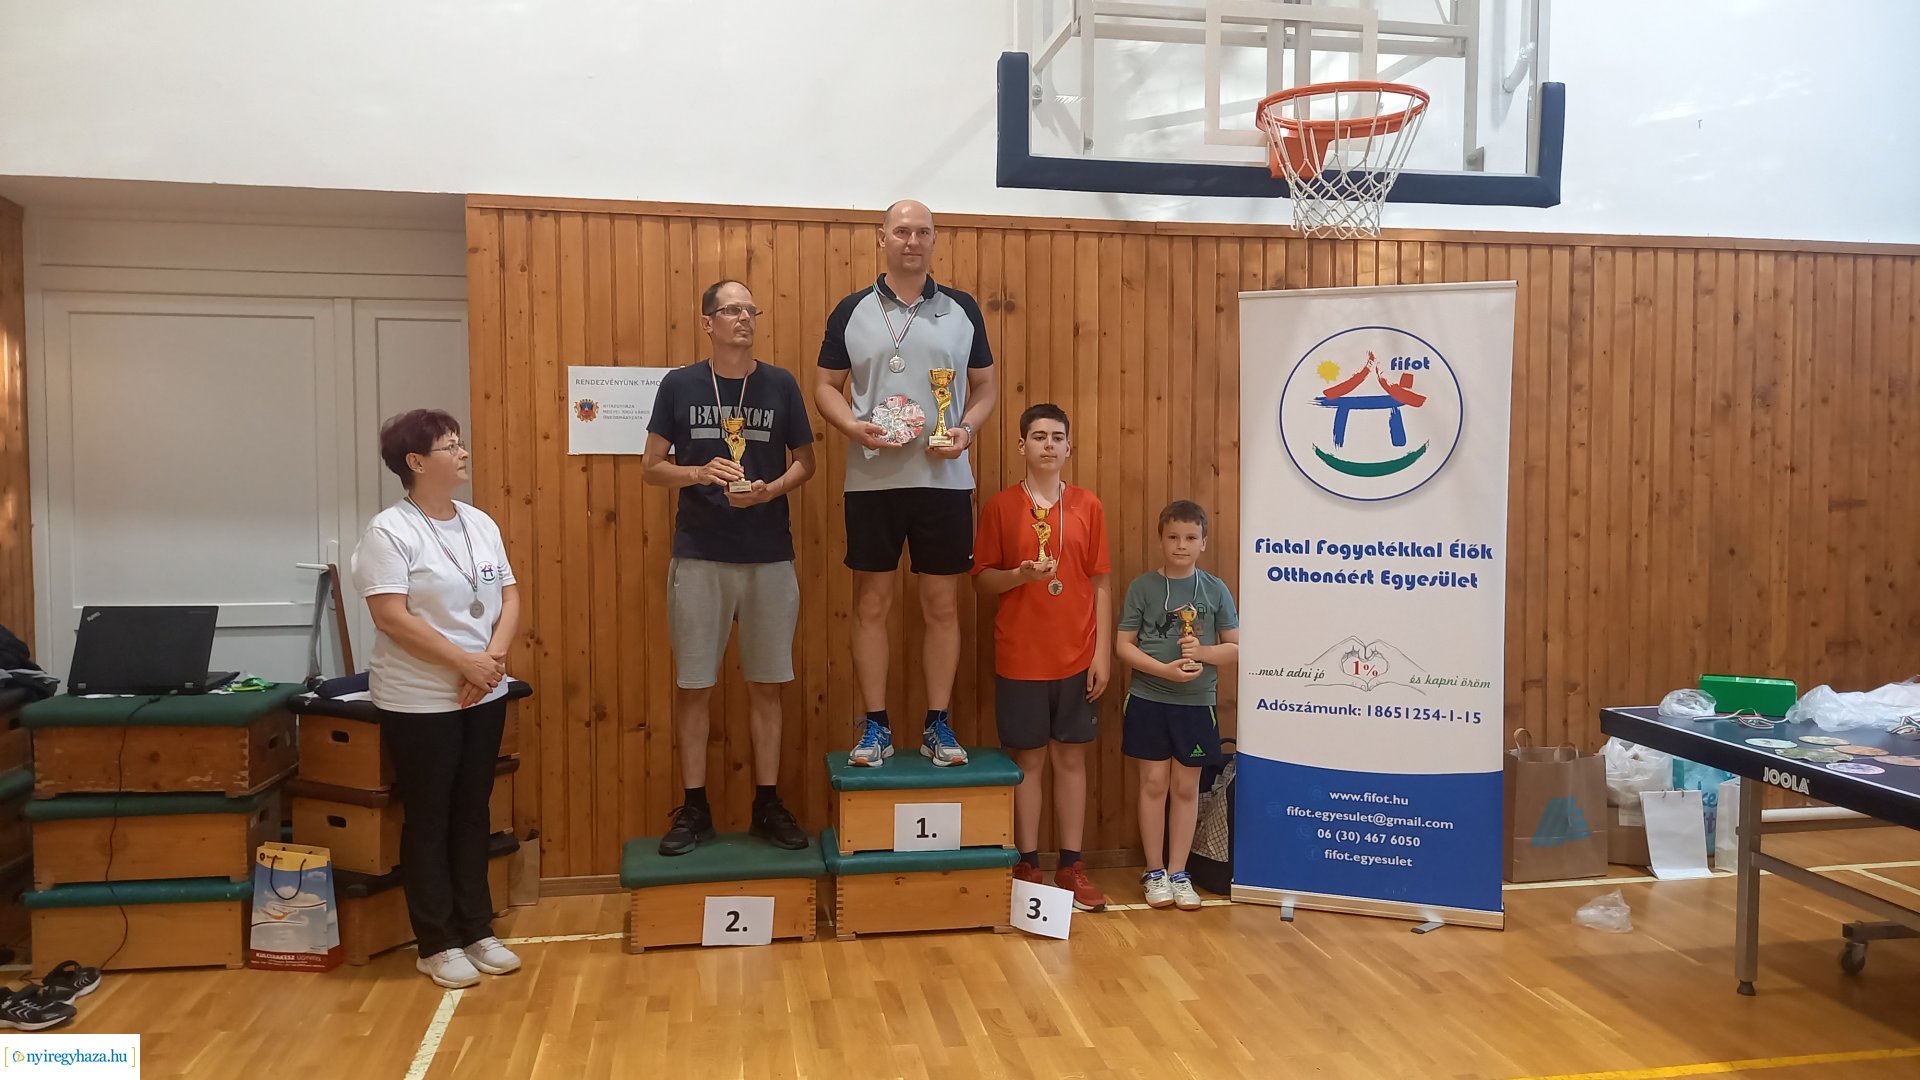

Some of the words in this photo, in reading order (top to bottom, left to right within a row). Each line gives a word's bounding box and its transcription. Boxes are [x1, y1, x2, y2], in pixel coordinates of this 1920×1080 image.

[1390, 356, 1431, 371] fifot
[575, 377, 639, 386] RENDEZVÉNYÜNK
[1255, 538, 1310, 554] Fiatal
[1316, 540, 1442, 560] Fogyatékkal
[1449, 539, 1493, 560] Élők
[1267, 566, 1374, 585] Otthonáért
[1380, 570, 1478, 590] Egyesület
[1286, 667, 1313, 679] adni
[1313, 669, 1325, 681] jó
[1352, 660, 1379, 677] 1%
[1409, 673, 1422, 684] és
[1424, 675, 1458, 688] kapni
[1462, 677, 1491, 689] öröm
[1256, 698, 1362, 716] Adószámunk:
[1367, 704, 1482, 724] 18651254-1-15
[1762, 766, 1809, 795] JOOLA
[1329, 791, 1409, 806] www.fifot.hu
[915, 817, 938, 839] 1.
[1286, 806, 1454, 830] fifot.egyesulet@gmail.com
[1317, 828, 1332, 840] 06
[1335, 830, 1361, 844] (30)
[1364, 832, 1387, 844] 467
[1390, 835, 1421, 847] 6050
[1324, 849, 1413, 867] fifot.egyesulet
[1026, 897, 1048, 922] 3.
[725, 910, 749, 933] 2.
